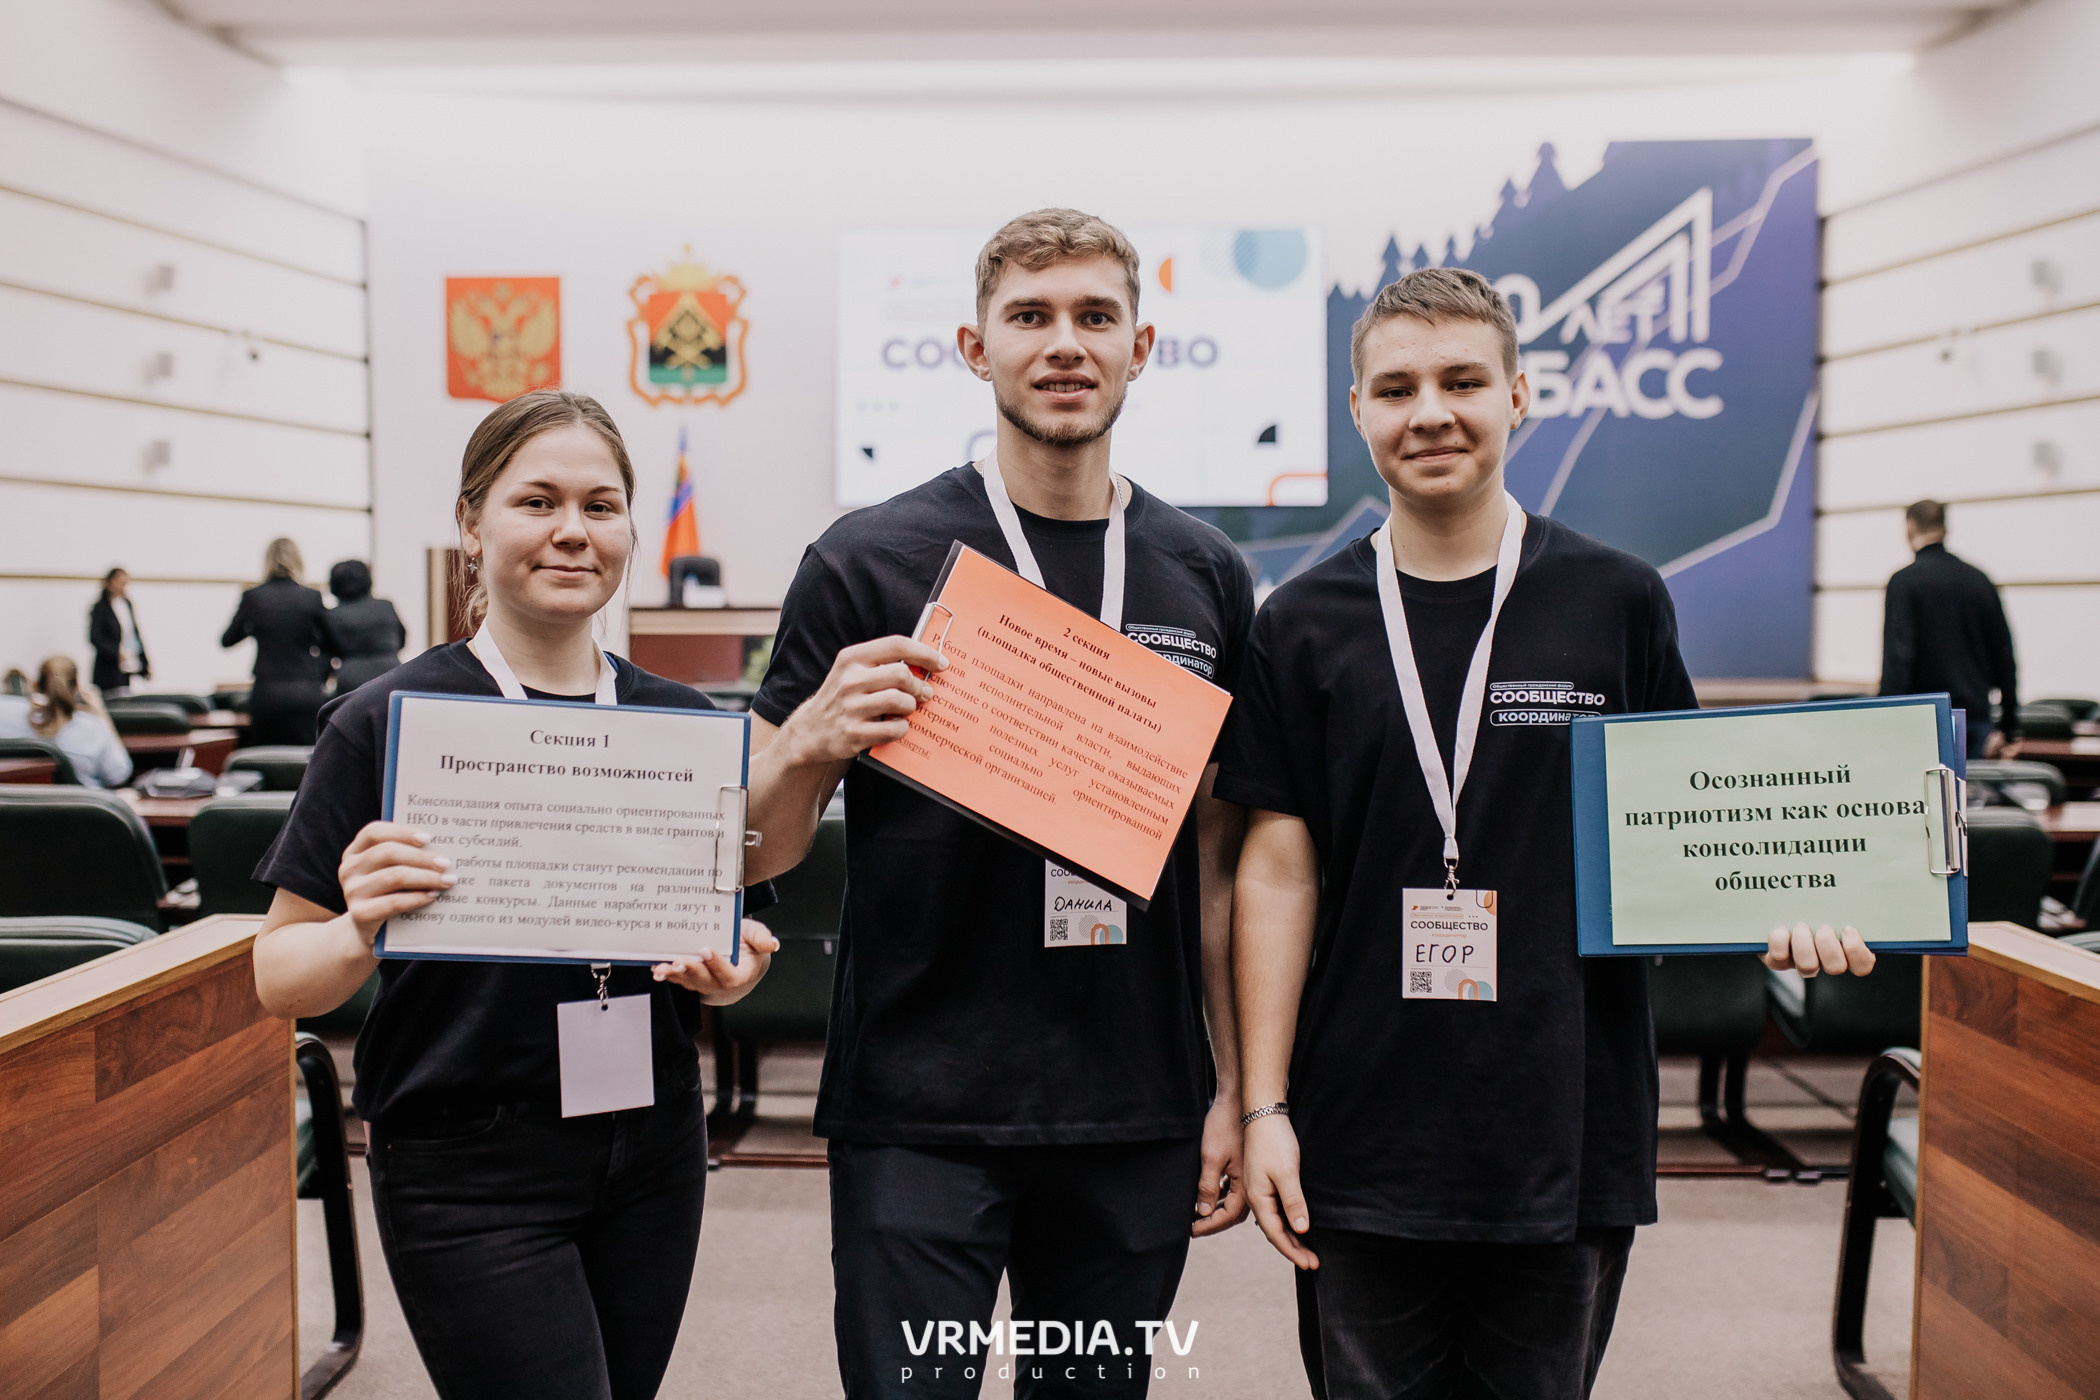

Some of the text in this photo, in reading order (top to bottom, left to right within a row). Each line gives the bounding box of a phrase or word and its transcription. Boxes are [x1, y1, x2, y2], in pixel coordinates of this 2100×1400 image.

[1525, 347, 1724, 419] БАСС
[1062, 626, 1110, 661] 2 секция
[1127, 632, 1216, 659] СООБЩЕСТВО
[999, 614, 1033, 640] Новое
[1035, 634, 1068, 660] время
[1079, 662, 1113, 684] новые
[1115, 678, 1156, 708] вызовы
[1163, 653, 1213, 676] рдинатор
[977, 625, 1162, 734] (площадка общественной палаты)
[932, 633, 967, 660] Рбота
[971, 657, 1024, 691] площадки
[1028, 687, 1087, 725] направлена
[1091, 721, 1104, 734] на
[1107, 731, 1188, 779] взаимодействие
[1490, 690, 1605, 705] СООБЩЕСТВО
[1499, 711, 1595, 724] координа
[530, 729, 610, 749] Секция 1
[979, 680, 1182, 794] исполнительной власти, выдающих
[908, 721, 1057, 806] коммерческой организацией.
[932, 694, 1169, 826] ественно полезных услуг установленным
[981, 700, 989, 710] о
[991, 706, 1059, 748] соответствии
[1061, 744, 1106, 773] качества
[1108, 769, 1175, 810] оказываемых
[440, 755, 694, 783] Пространство возможностей
[916, 704, 1163, 841] итериям социально ориентированной
[1689, 764, 1852, 791] Осознанный
[407, 794, 725, 822] Консолидация опыта социально ориентированных
[1625, 799, 1926, 830] патриотизм как основа
[407, 812, 439, 826] НКО
[441, 817, 448, 826] в
[452, 816, 487, 827] части
[491, 818, 572, 832] привлечения
[575, 823, 622, 835] средств
[626, 825, 632, 834] в
[636, 826, 664, 836] виде
[667, 828, 714, 839] грантов
[1682, 837, 1867, 859] консолидации
[455, 856, 502, 870] работы
[505, 858, 569, 872] площадки
[572, 861, 613, 874] станут
[616, 864, 704, 878] рекомендации
[488, 877, 531, 888] пакета
[543, 879, 618, 892] документов
[630, 883, 645, 893] на
[1715, 870, 1837, 892] общества
[475, 894, 541, 908] конкурсы.
[548, 894, 598, 910] Данные
[604, 899, 668, 913] наработки
[674, 903, 707, 915] лягут
[714, 904, 721, 913] в
[400, 911, 720, 932] основу одного из модулей видео-курса и войдут в
[1410, 920, 1488, 931] СООБЩЕСТВО
[1416, 944, 1474, 964] ЕГОР
